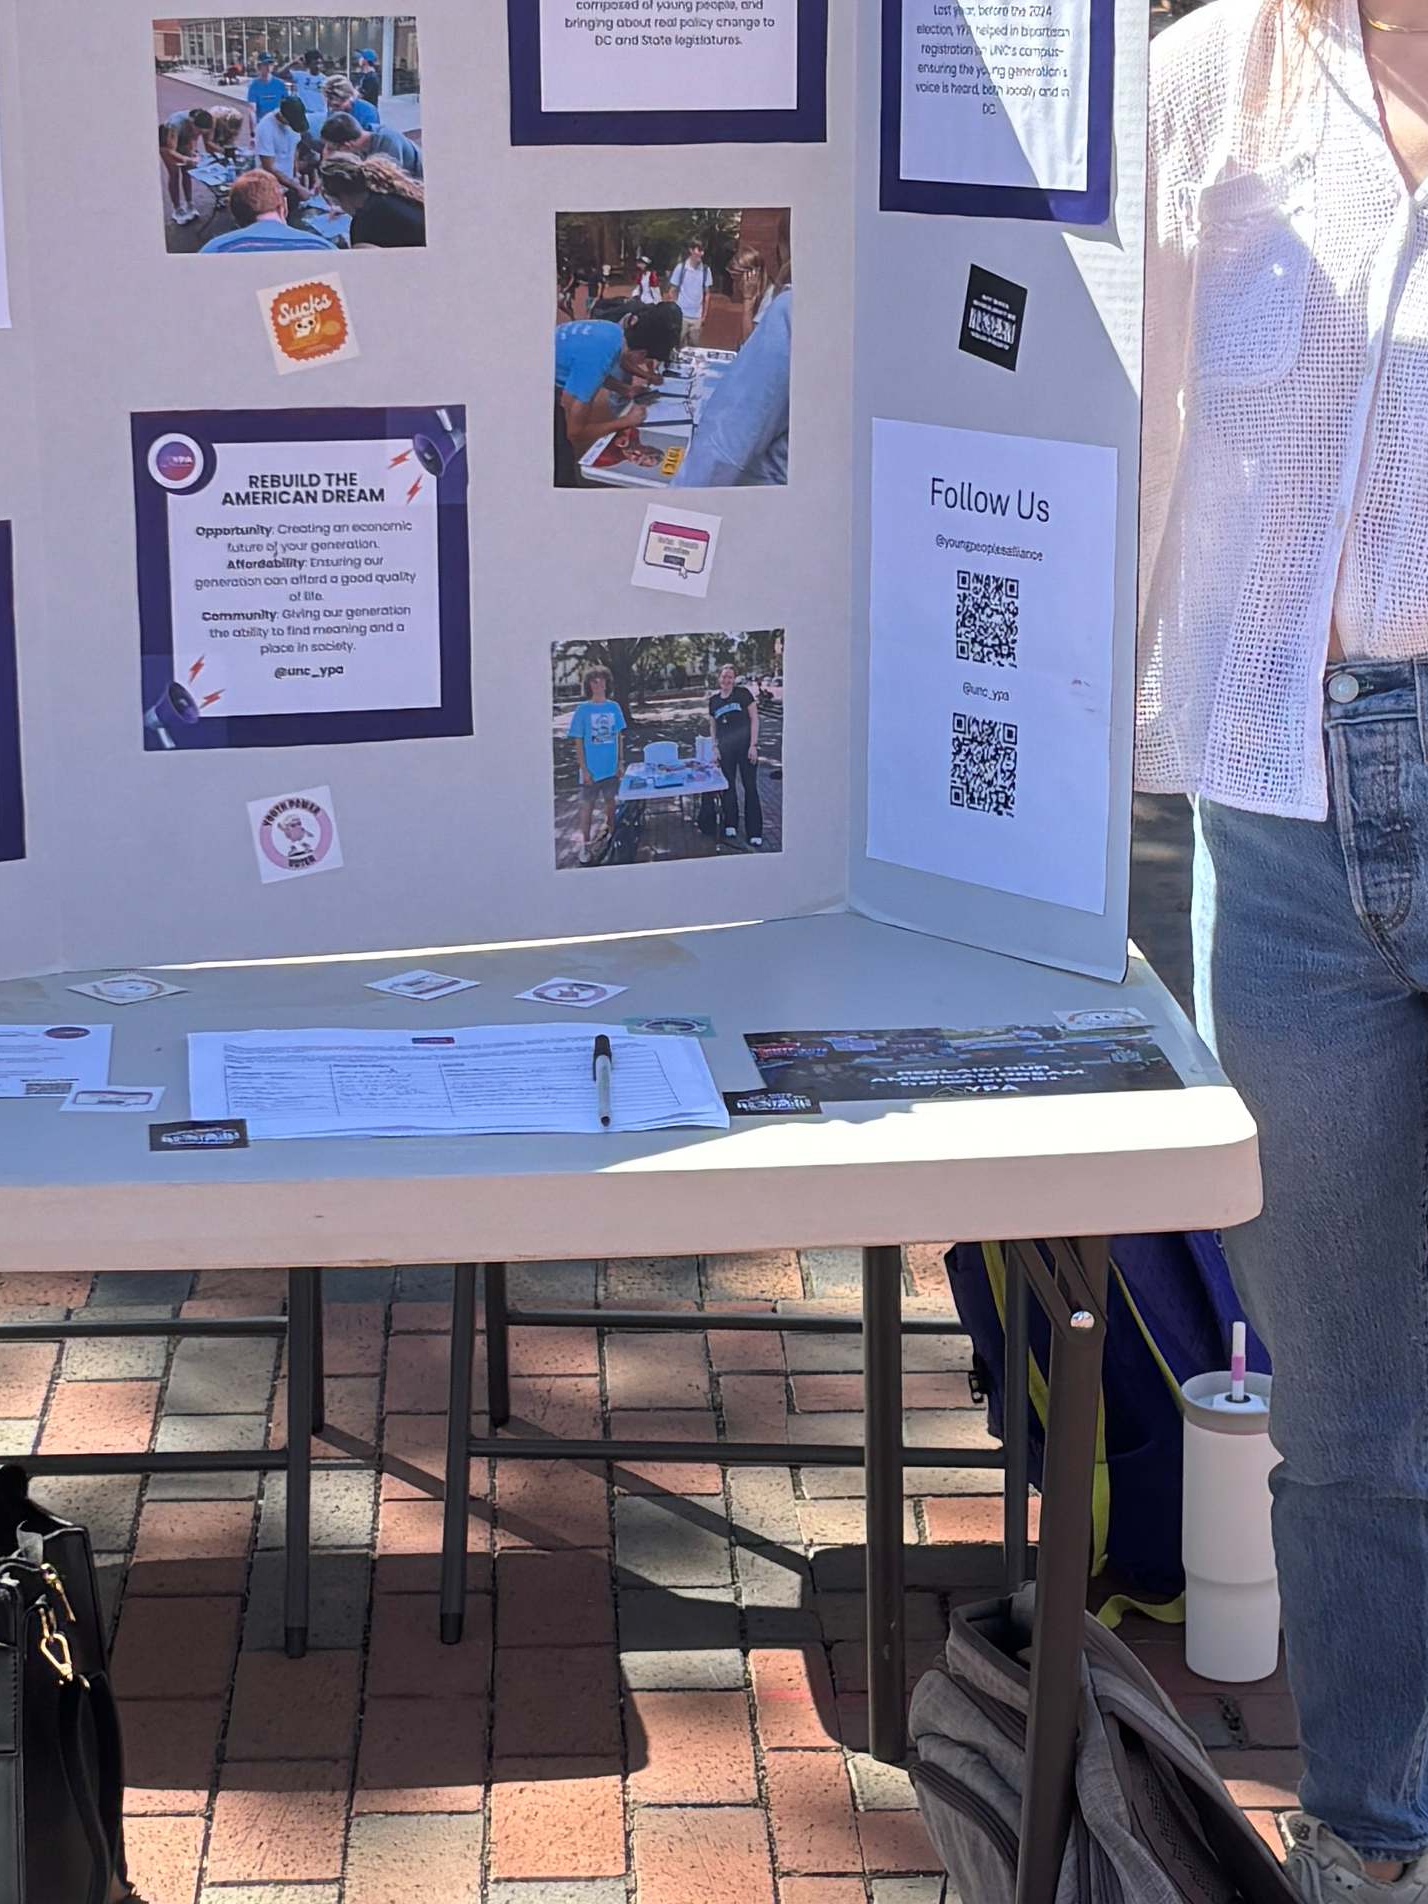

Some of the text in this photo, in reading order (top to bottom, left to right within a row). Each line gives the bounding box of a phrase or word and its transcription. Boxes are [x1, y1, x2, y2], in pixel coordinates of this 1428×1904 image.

[278, 294, 332, 326] Sucks
[248, 472, 357, 489] REBUILD THE
[222, 488, 385, 506] AMERICAN DREAM
[932, 478, 1049, 522] Follow Us
[196, 520, 413, 539] Opportunity: Creating an economic
[227, 542, 263, 553] future
[282, 543, 307, 554] your
[227, 556, 384, 570] Affordability: Ensuring our
[195, 571, 416, 590] generation can afford a good quality
[202, 606, 410, 623] Community: Giving our generation
[210, 623, 404, 639] the ability to find meaning and a
[260, 641, 356, 656] place in society.
[274, 664, 344, 679] @unc_ypa
